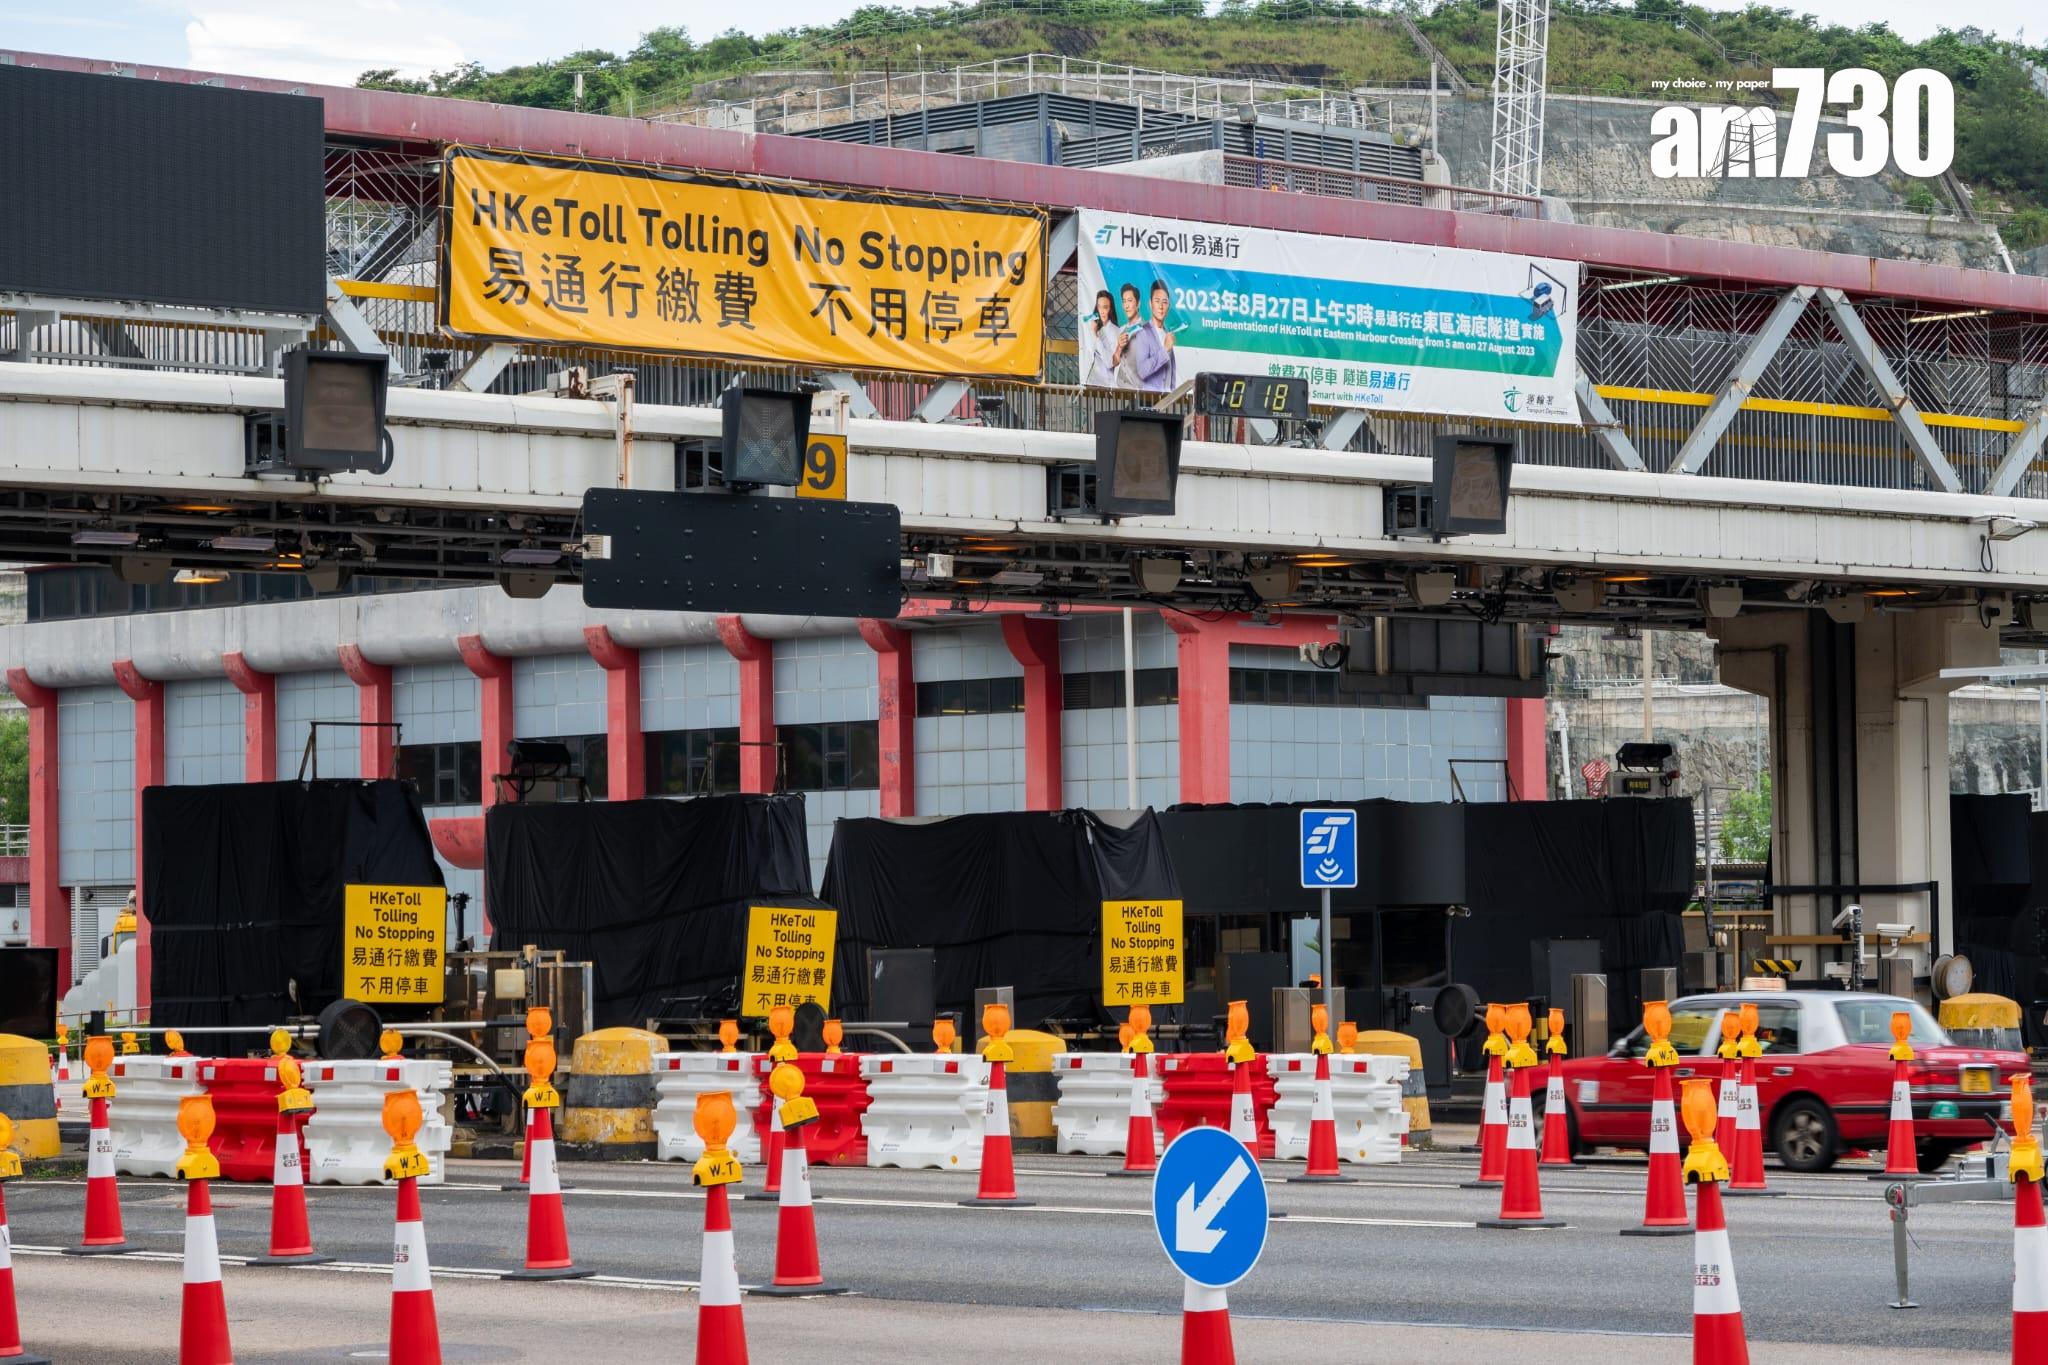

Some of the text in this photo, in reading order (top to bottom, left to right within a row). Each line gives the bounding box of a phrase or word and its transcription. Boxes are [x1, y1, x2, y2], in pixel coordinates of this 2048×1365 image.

[471, 187, 1029, 287] HKeToll Tolling No Stopping
[1120, 226, 1240, 259] HKeToll 易通行
[481, 247, 1018, 346] 易通行繳費 不用停車
[1202, 317, 1268, 333] Implementation
[1268, 323, 1279, 334] of
[1280, 325, 1312, 337] HKeToll
[1313, 328, 1322, 337] at
[1323, 328, 1354, 341] Eastern
[1355, 331, 1388, 343] Harbour
[1389, 334, 1424, 348] Crossing
[1425, 336, 1444, 348] from
[1445, 339, 1451, 349] 5
[1452, 341, 1465, 350] am
[1466, 342, 1476, 350] on
[1478, 342, 1487, 352] 27
[1488, 343, 1514, 355] August
[1343, 368, 1411, 391] 隧道易通行
[1221, 381, 1289, 411] 10 18
[1312, 390, 1384, 404] Smart with HKeToll
[806, 442, 836, 491] 9
[369, 891, 421, 906] HKeToll
[373, 908, 418, 925] Tolling
[770, 913, 815, 928] HKeToll
[1122, 906, 1163, 918] HKeToll
[355, 926, 435, 942] No Stopping
[1125, 921, 1161, 934] Tolling
[773, 929, 812, 945] Tolling
[1111, 936, 1175, 950] No Stopping
[756, 945, 825, 963] No Stopping
